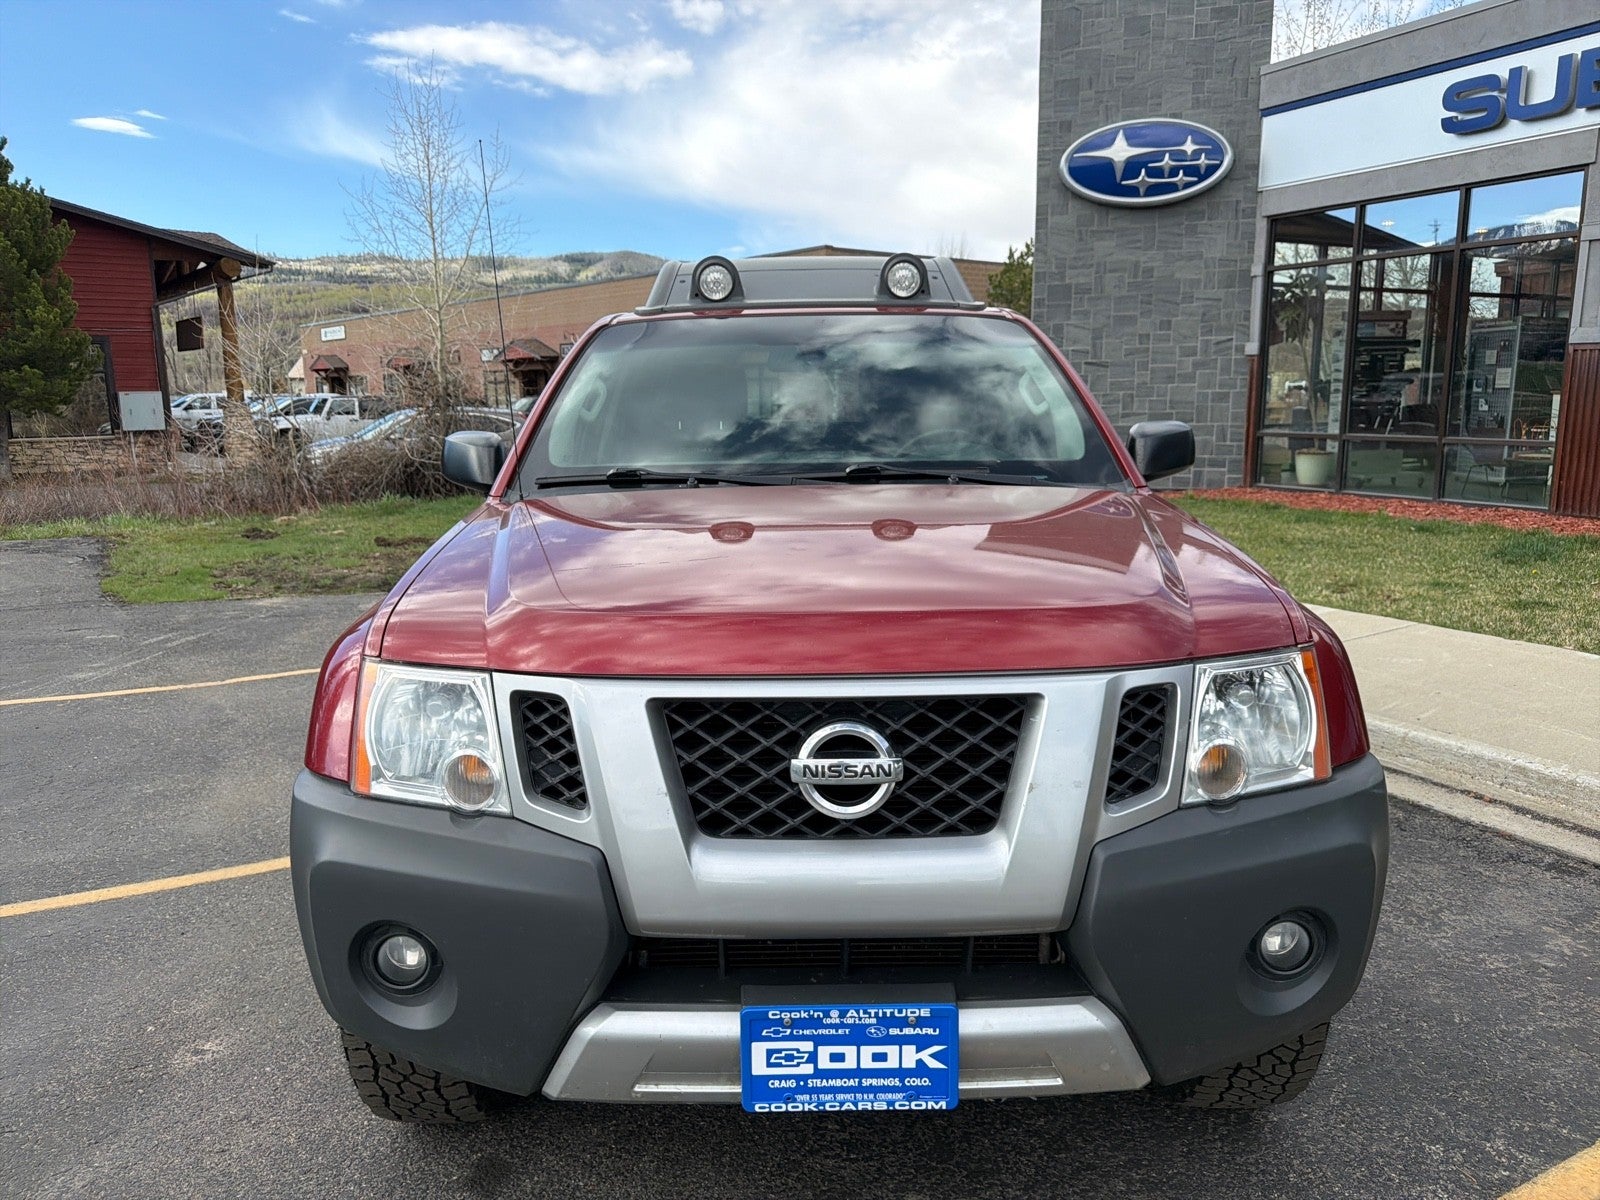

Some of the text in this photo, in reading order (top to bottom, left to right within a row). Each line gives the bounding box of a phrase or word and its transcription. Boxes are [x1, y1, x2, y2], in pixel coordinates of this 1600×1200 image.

[802, 763, 892, 778] NISSAN
[768, 1009, 823, 1019] Cook'n
[846, 1008, 931, 1018] ALTITUDE
[823, 1017, 877, 1025] cook-cars.com
[793, 1028, 850, 1036] CHEVROLET
[888, 1027, 939, 1035] SUBARU
[751, 1041, 948, 1076] COOK
[768, 1077, 932, 1088] CRAIG STEAMBOAT SPRINGS, COLO.
[835, 1093, 855, 1101] SERVICE
[855, 1093, 863, 1101] TO
[754, 1101, 947, 1112] COOK-CARS.COM
